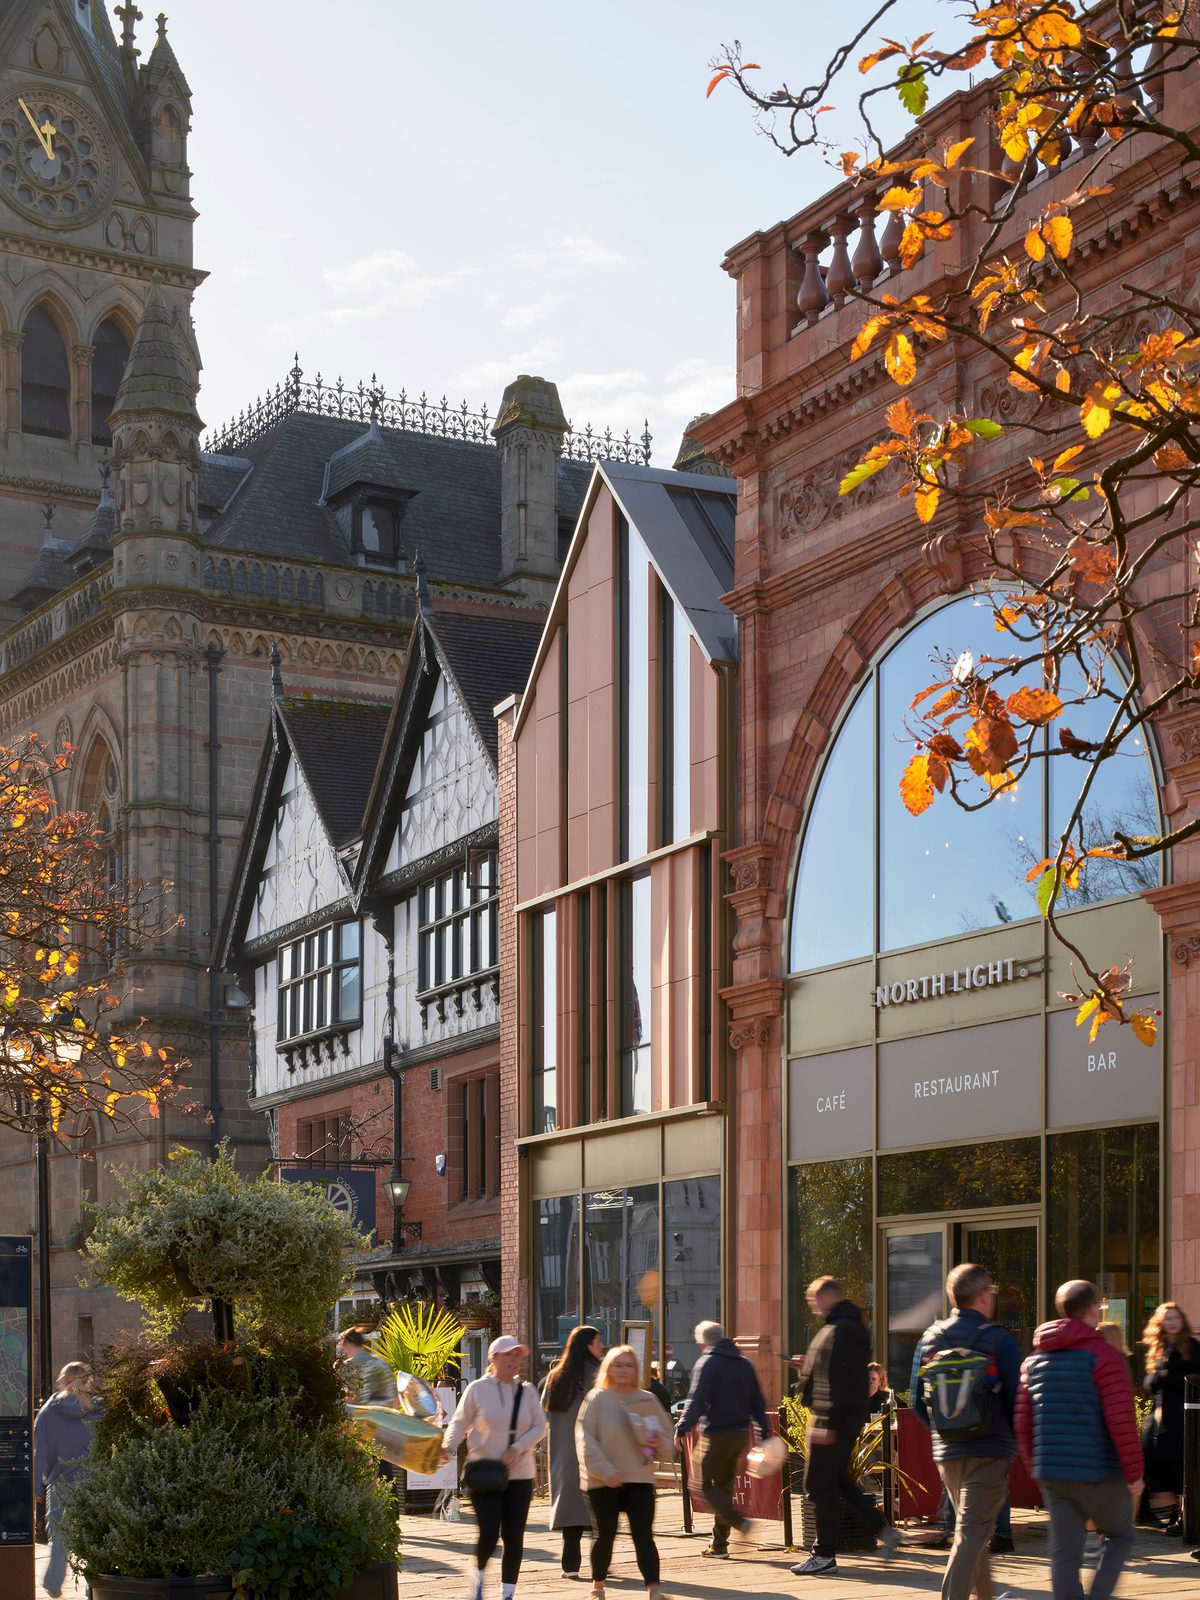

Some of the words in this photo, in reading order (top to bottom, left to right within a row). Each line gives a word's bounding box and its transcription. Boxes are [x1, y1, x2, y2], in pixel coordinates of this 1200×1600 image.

[876, 973, 946, 1007] NORTH
[1087, 1052, 1117, 1072] BAR
[914, 1070, 1000, 1098] RESTAURANT
[816, 1090, 846, 1113] CAFÉ
